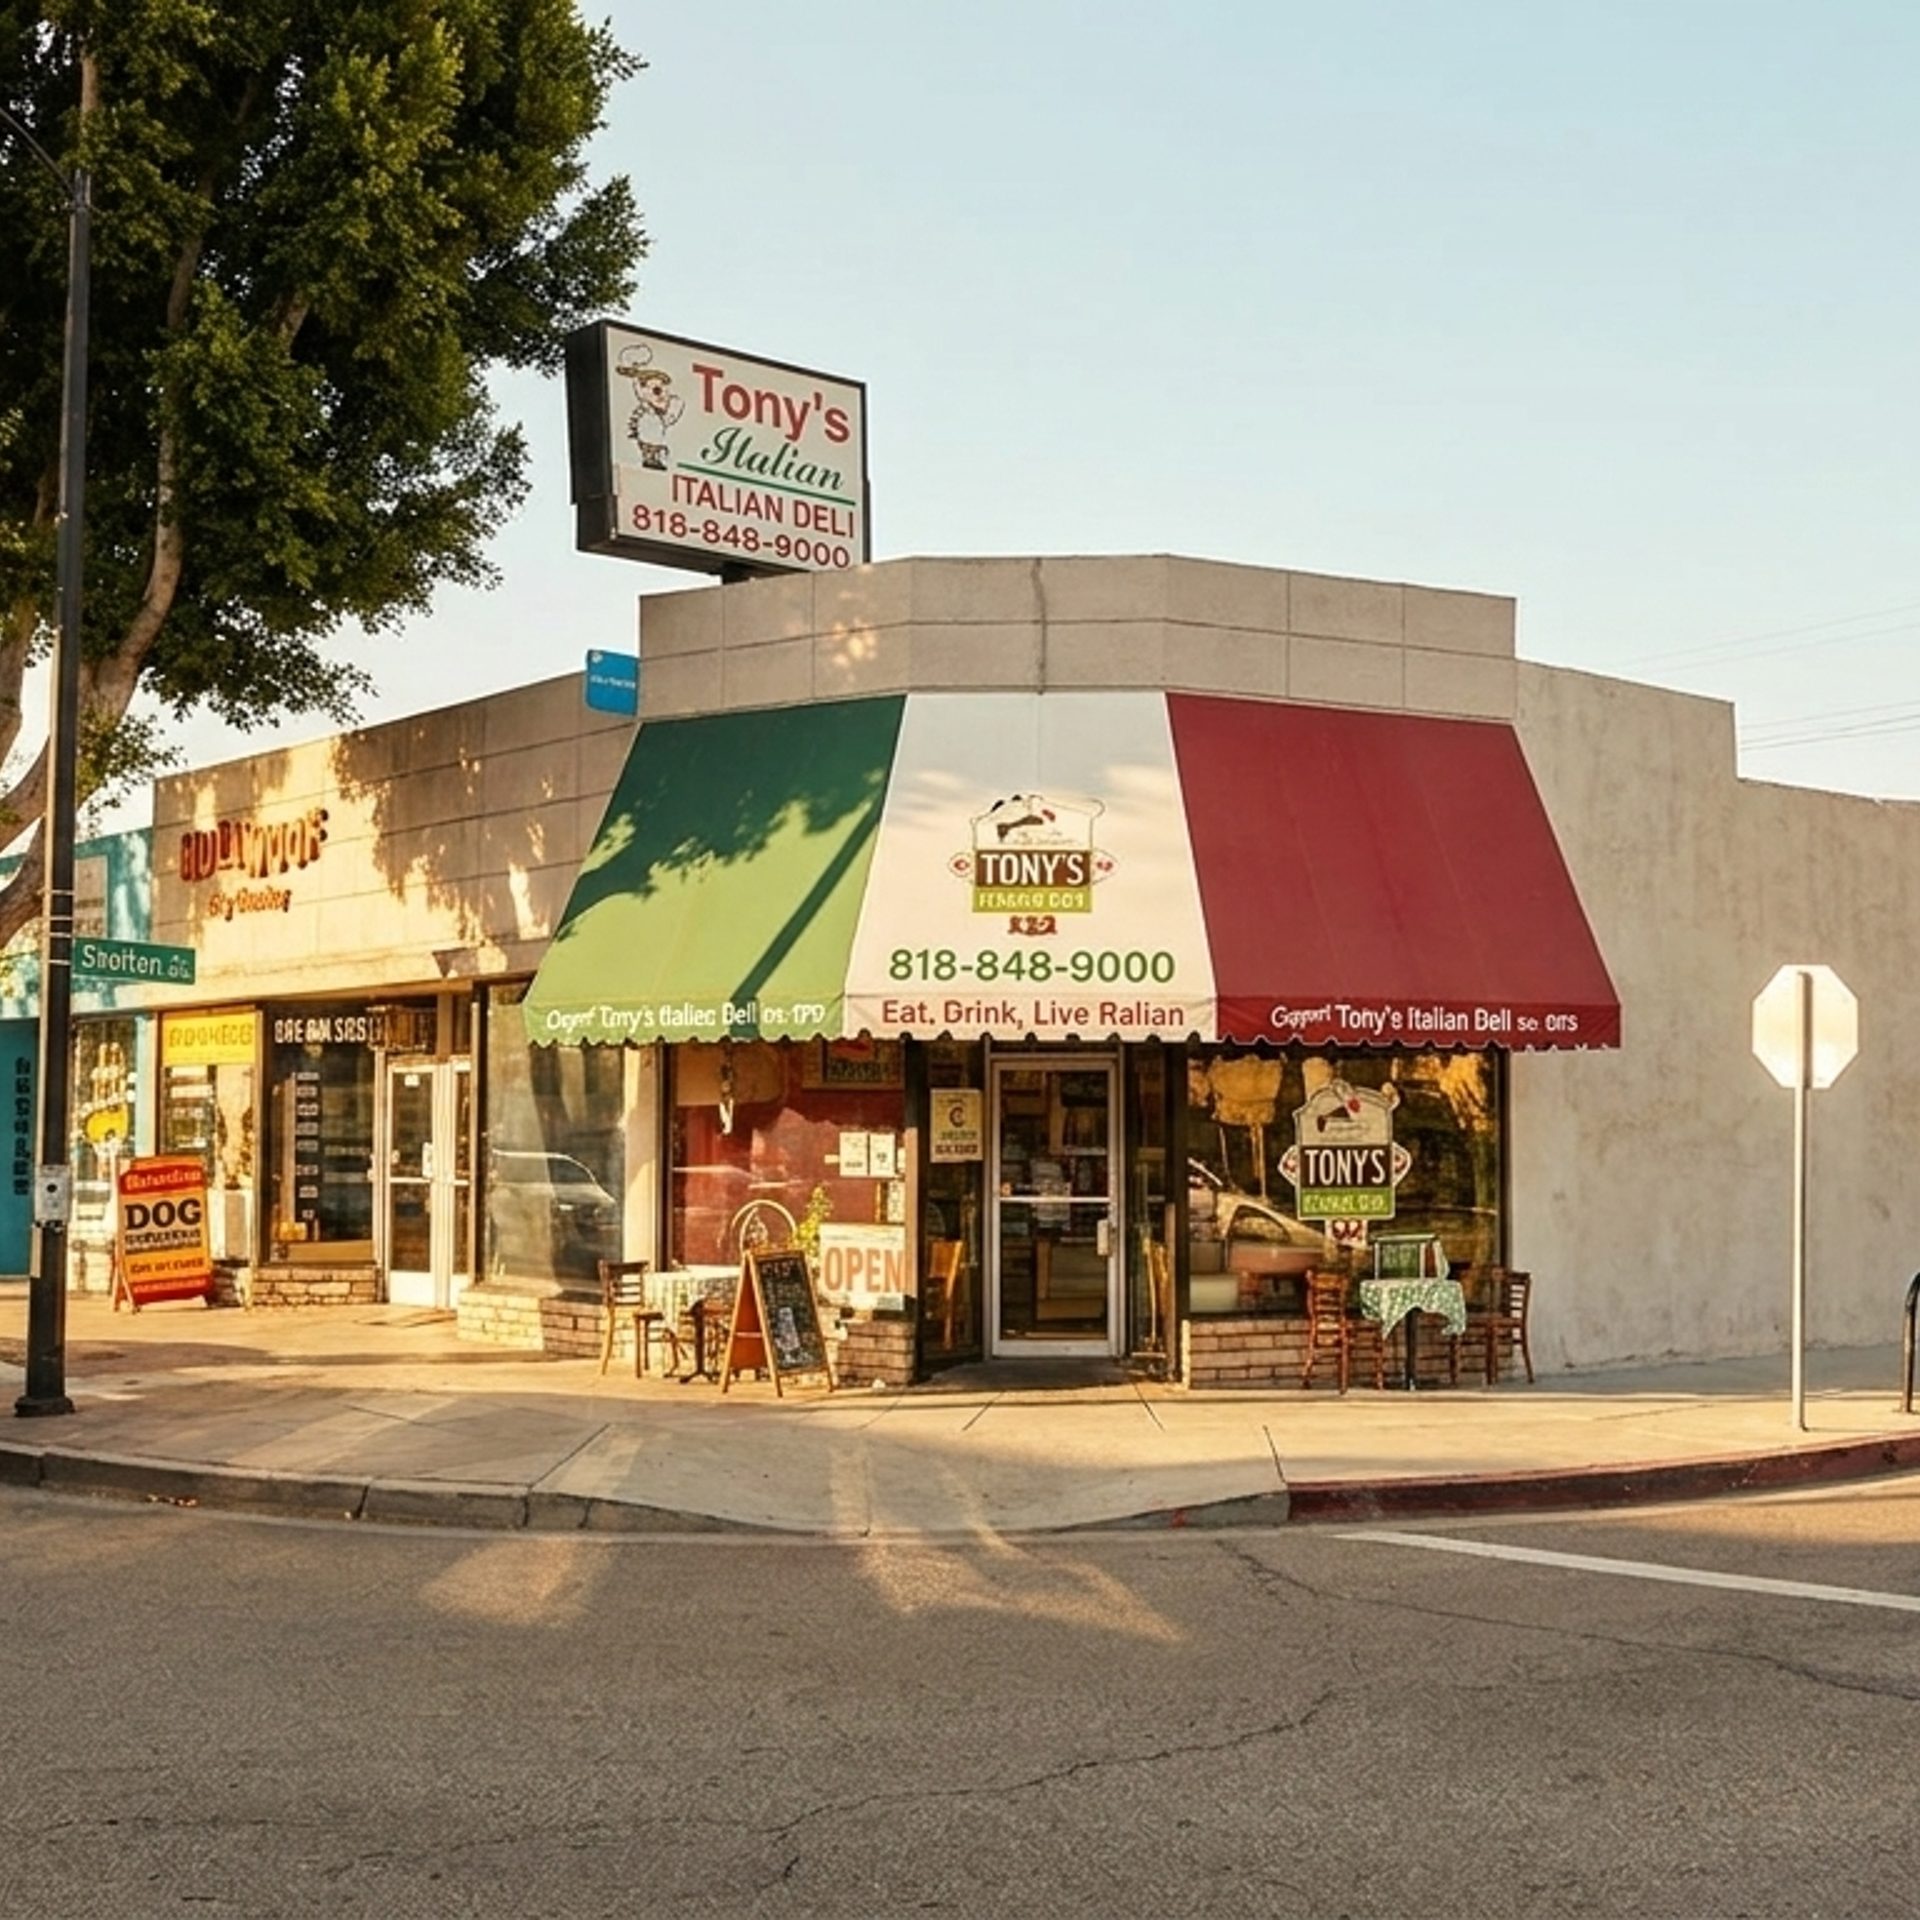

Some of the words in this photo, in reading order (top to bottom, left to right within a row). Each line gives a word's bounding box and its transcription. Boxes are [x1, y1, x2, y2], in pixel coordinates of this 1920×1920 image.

[692, 363, 850, 442] Tony's
[701, 427, 844, 490] Italian
[672, 474, 783, 523] ITALIAN
[793, 500, 854, 538] DELI
[632, 504, 851, 569] 818-848-9000
[980, 853, 1084, 886] TONY'S
[889, 949, 1176, 984] 818-848-9000
[1034, 1000, 1090, 1025] Live
[1099, 1001, 1184, 1026] Ralian
[1334, 1004, 1403, 1036] Tony's
[1407, 1006, 1469, 1031] Italian
[1474, 1007, 1511, 1031] Bell
[1304, 1149, 1386, 1186] TONYS
[125, 1198, 202, 1231] DOG
[824, 1246, 905, 1294] OPEN
